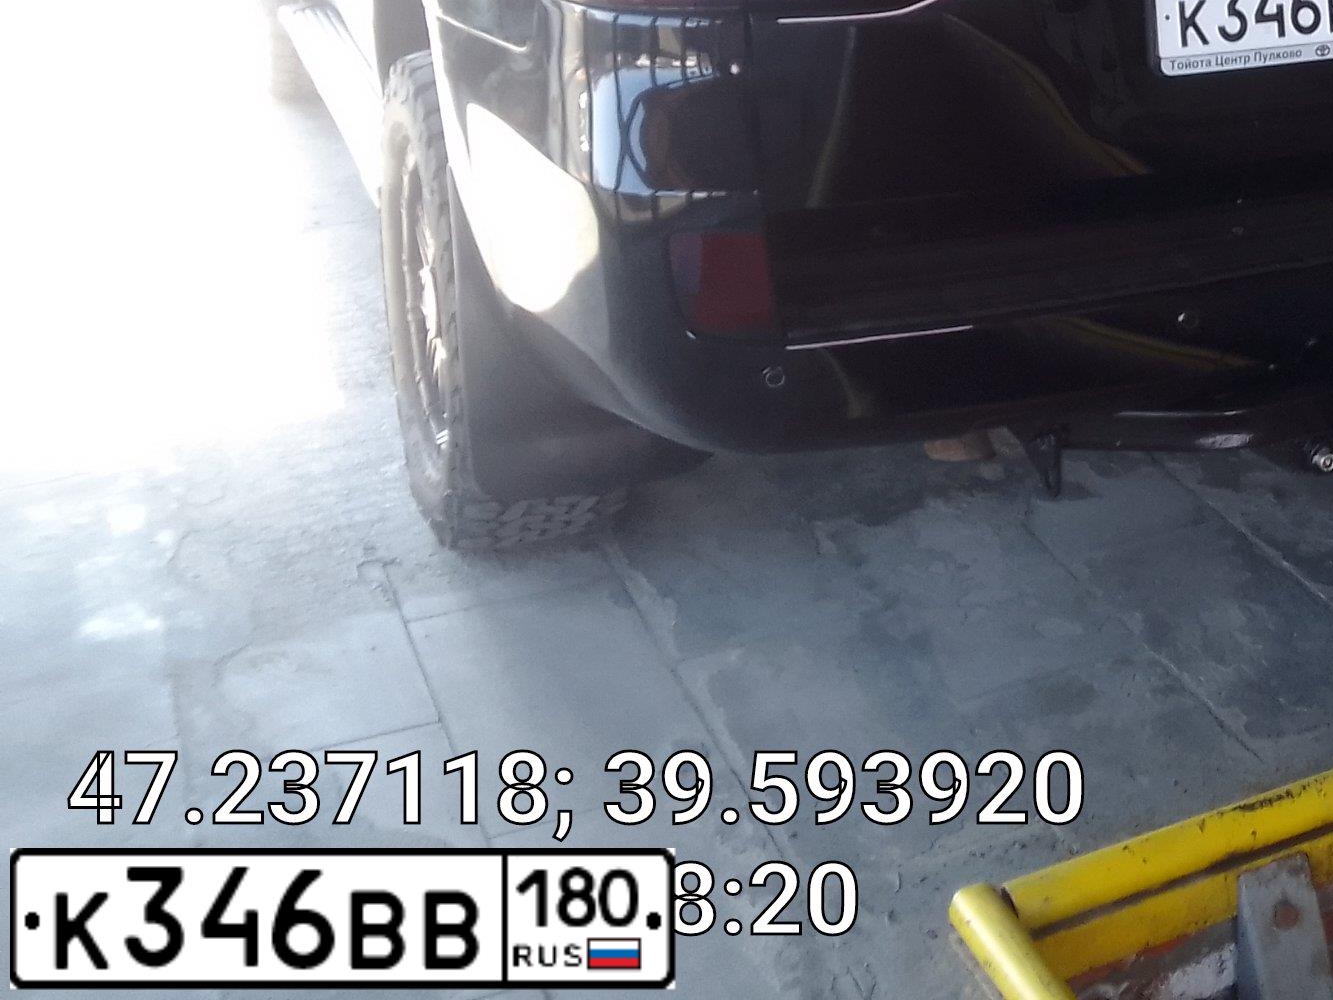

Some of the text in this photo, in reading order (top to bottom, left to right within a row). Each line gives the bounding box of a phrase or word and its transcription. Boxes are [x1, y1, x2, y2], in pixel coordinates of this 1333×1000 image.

[1170, 57, 1212, 71] Тойота
[1215, 54, 1250, 67] Центр
[1253, 50, 1303, 64] Пулково
